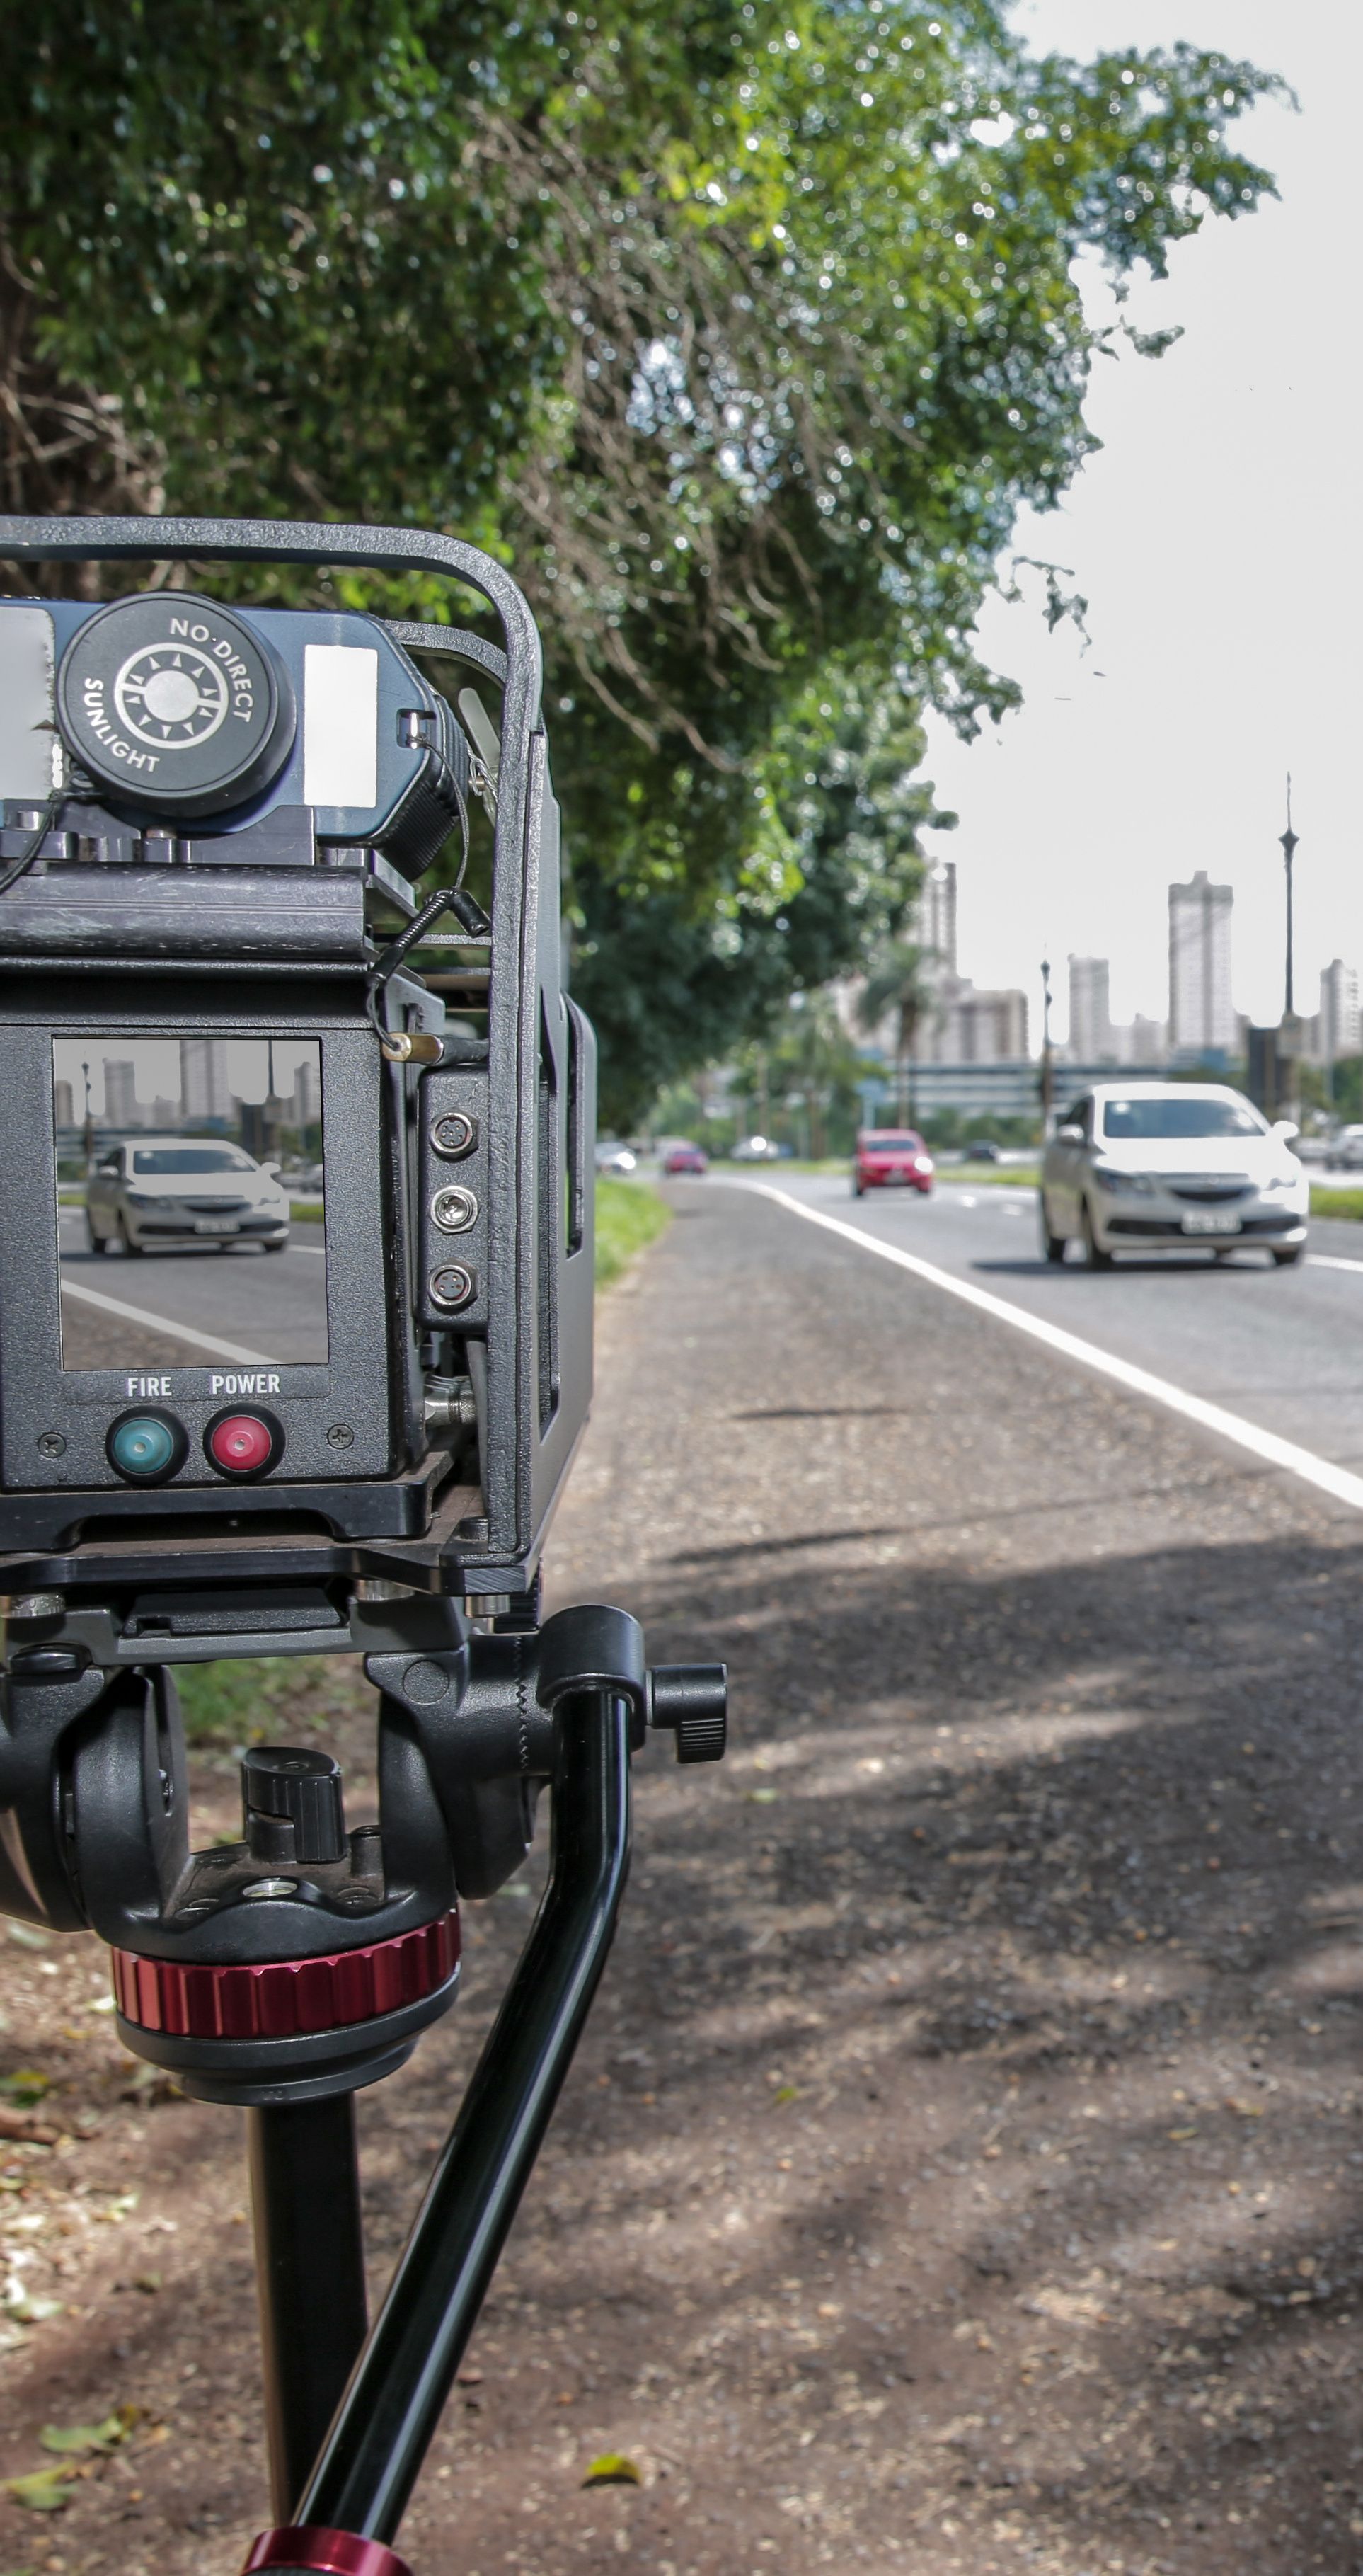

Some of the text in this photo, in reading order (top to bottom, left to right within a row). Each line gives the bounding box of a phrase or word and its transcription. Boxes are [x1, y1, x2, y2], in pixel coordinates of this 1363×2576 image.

[169, 617, 254, 723] NO DIRECT
[84, 677, 161, 772] SUNLIGHT
[127, 1377, 172, 1397] FIRE
[212, 1374, 281, 1395] POWER
